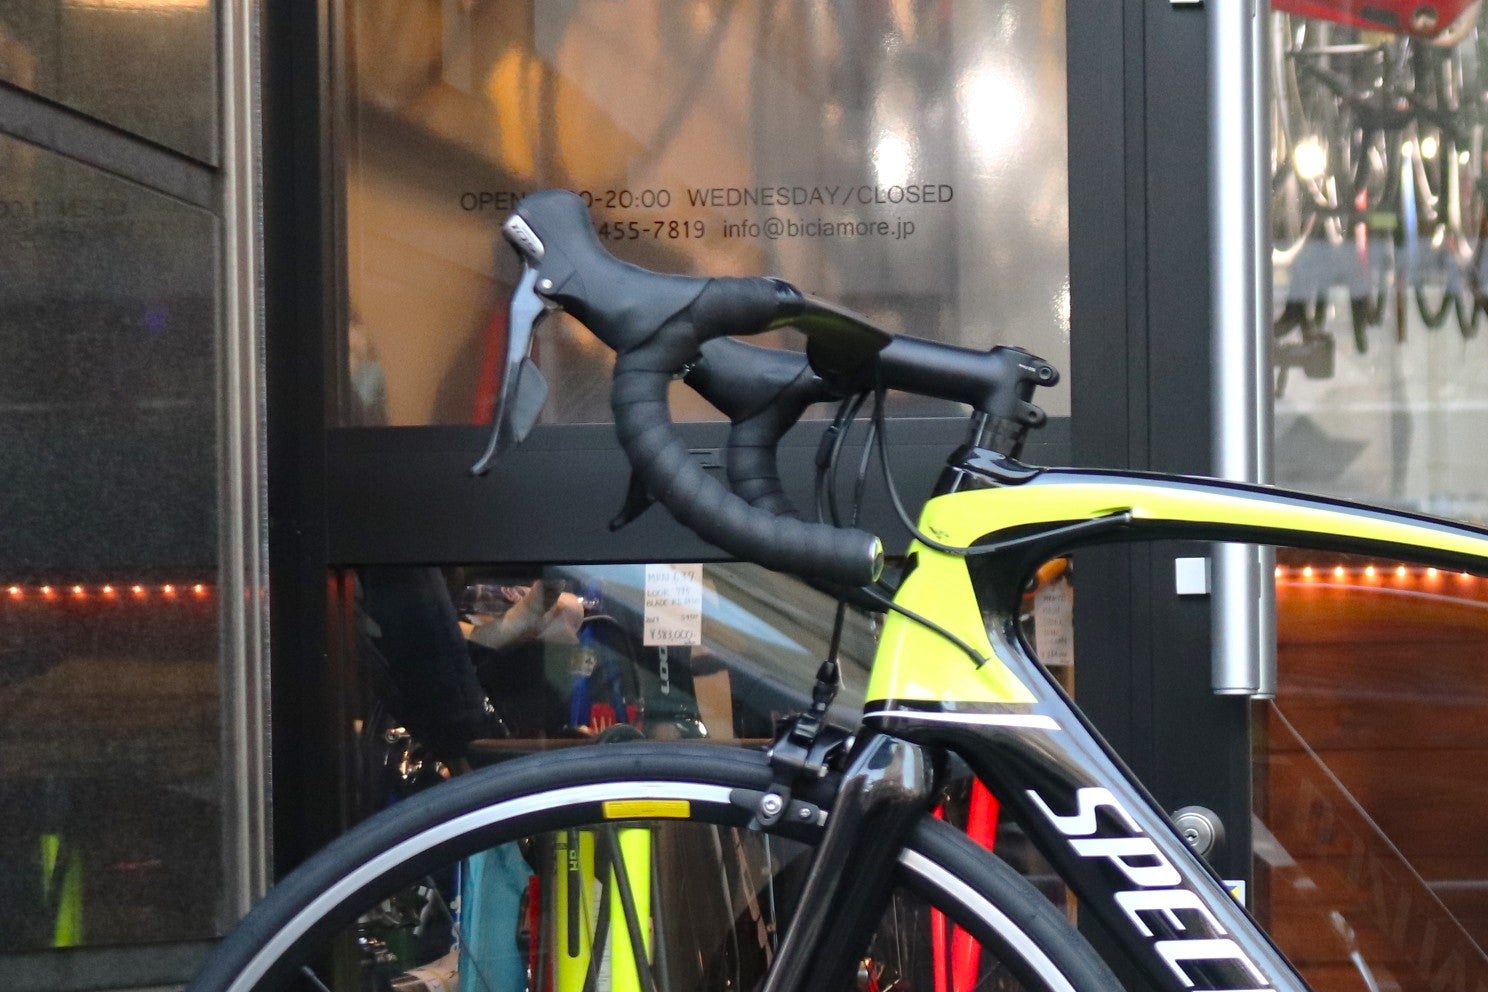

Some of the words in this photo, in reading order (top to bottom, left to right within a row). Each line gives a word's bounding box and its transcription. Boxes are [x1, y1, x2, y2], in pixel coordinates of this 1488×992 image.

[460, 190, 525, 211] OPEN
[687, 184, 954, 207] WEDNESDAY/CLOSED
[723, 216, 916, 240] info@biciamore.jp
[659, 645, 670, 695] LOO
